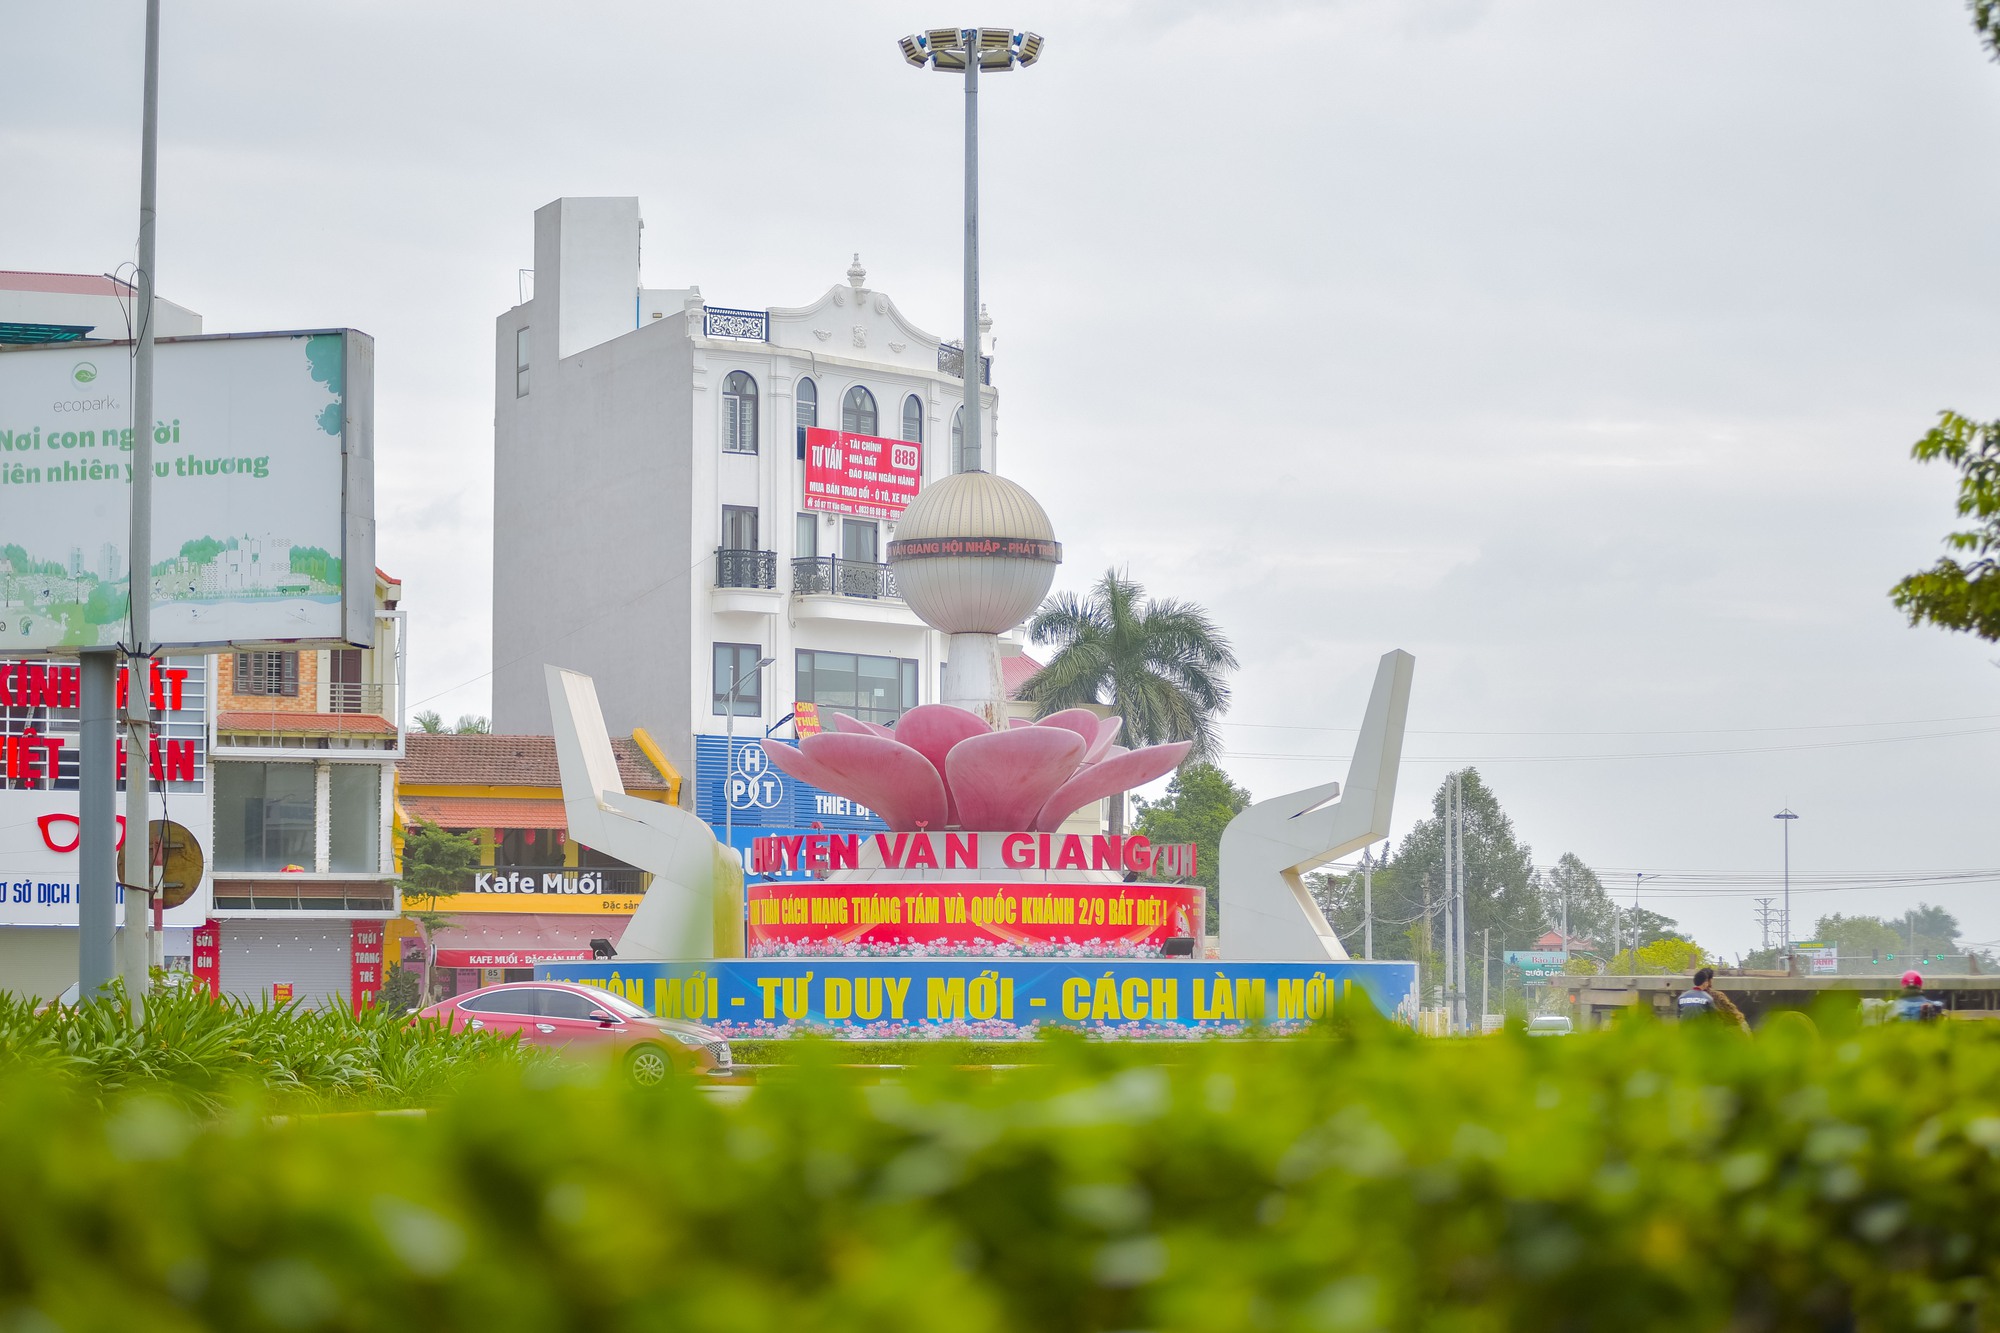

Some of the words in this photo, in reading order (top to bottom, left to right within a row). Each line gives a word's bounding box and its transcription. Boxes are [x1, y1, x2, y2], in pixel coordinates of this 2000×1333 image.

[53, 395, 115, 413] ecopark
[47, 431, 95, 450] con
[102, 419, 180, 452] ngời
[850, 438, 860, 449] TÀI
[861, 441, 882, 453] CHÍNH
[812, 445, 824, 468] TƯ
[825, 441, 843, 470] VẤN
[849, 454, 863, 465] NHÀ
[864, 455, 877, 467] ĐẤT
[895, 449, 916, 466] 888
[2, 462, 41, 484] iên
[47, 458, 119, 483] nhiên
[124, 461, 169, 484] yu
[175, 454, 269, 479] thương
[848, 467, 862, 479] ĐÁO
[863, 470, 877, 482] HẠN
[878, 472, 896, 484] NGÂN
[897, 474, 915, 487] HÀNG
[809, 481, 825, 493] MUA
[825, 482, 840, 495] BÁN
[841, 485, 857, 497] TRAO
[858, 485, 870, 499] ĐỔI
[892, 493, 900, 503] XE
[907, 542, 939, 554] GIANG
[941, 539, 962, 555] HỘI
[965, 539, 1000, 556] NHẬP
[1008, 541, 1036, 554] PHÁT
[0, 659, 80, 708] KÍNH
[797, 702, 814, 712] CHO
[796, 715, 820, 727] THUÊ
[0, 727, 65, 788] IỆT
[752, 821, 859, 878] HUYỆN
[875, 820, 978, 869] VĂN
[1001, 832, 1151, 873] GIANG
[13, 879, 32, 903] SỞ
[37, 883, 70, 907] DỊCH
[475, 872, 535, 893] Kafe
[542, 872, 602, 894] Muối
[602, 901, 621, 912] Đặc
[782, 893, 808, 925] CÁCH
[811, 897, 848, 929] MẠNG
[852, 893, 900, 925] THÁNG
[905, 893, 939, 924] TÁM
[943, 893, 966, 924] VÀ
[971, 888, 1017, 927] QUỐC
[1021, 893, 1074, 925] KHÁNH
[1079, 897, 1105, 925] 2/9
[1109, 890, 1134, 925] BẤT
[355, 952, 379, 964] TRANG
[469, 956, 493, 964] KAFE
[495, 952, 518, 964] MUỐI
[487, 969, 498, 977] 85
[653, 970, 718, 1018] MỚI
[757, 971, 814, 1019] TƯ
[824, 977, 912, 1020] DUY
[926, 970, 1014, 1020] MỚI
[1062, 971, 1178, 1020] CÁCH
[1192, 971, 1265, 1020] LÀM
[1277, 971, 1334, 1020] MỚI
